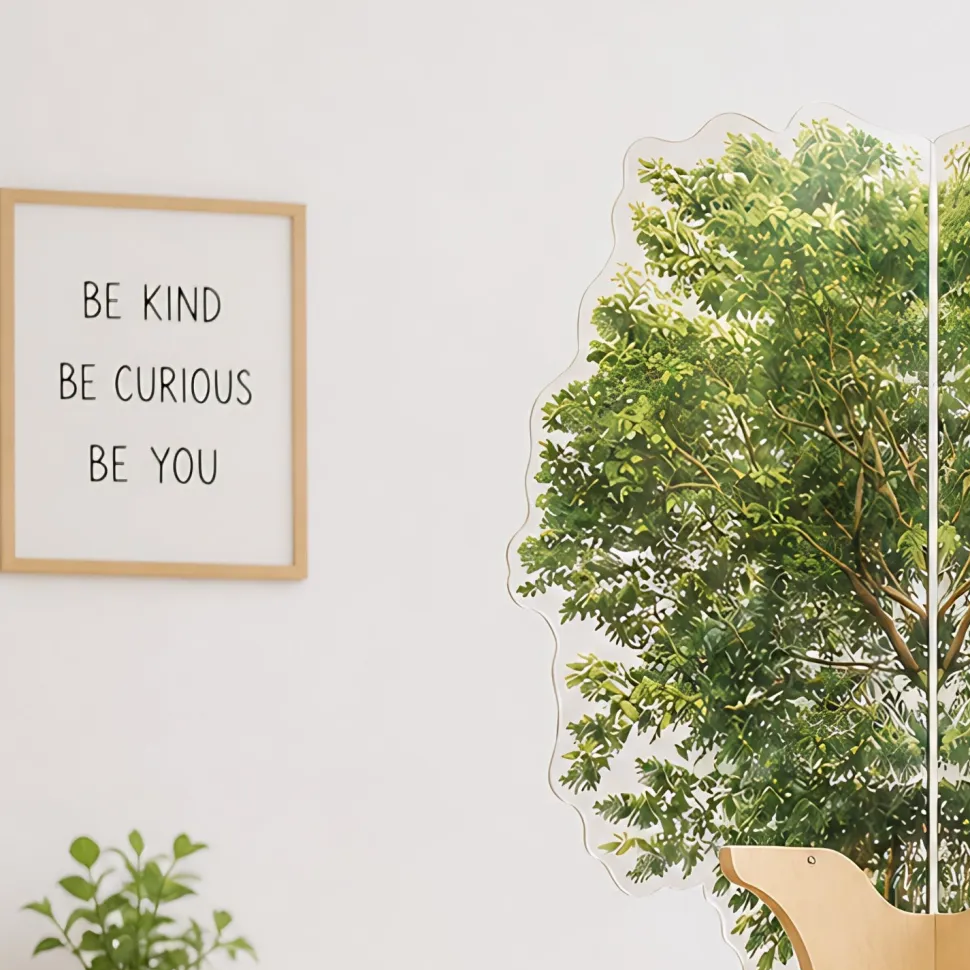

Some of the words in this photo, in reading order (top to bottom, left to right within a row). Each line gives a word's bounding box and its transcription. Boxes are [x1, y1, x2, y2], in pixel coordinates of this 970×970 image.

[83, 280, 121, 319] BE
[143, 283, 221, 323] KIND
[59, 362, 96, 401] BE
[114, 364, 252, 406] CURIOUS
[89, 444, 128, 483] BE
[150, 446, 217, 485] YOU
